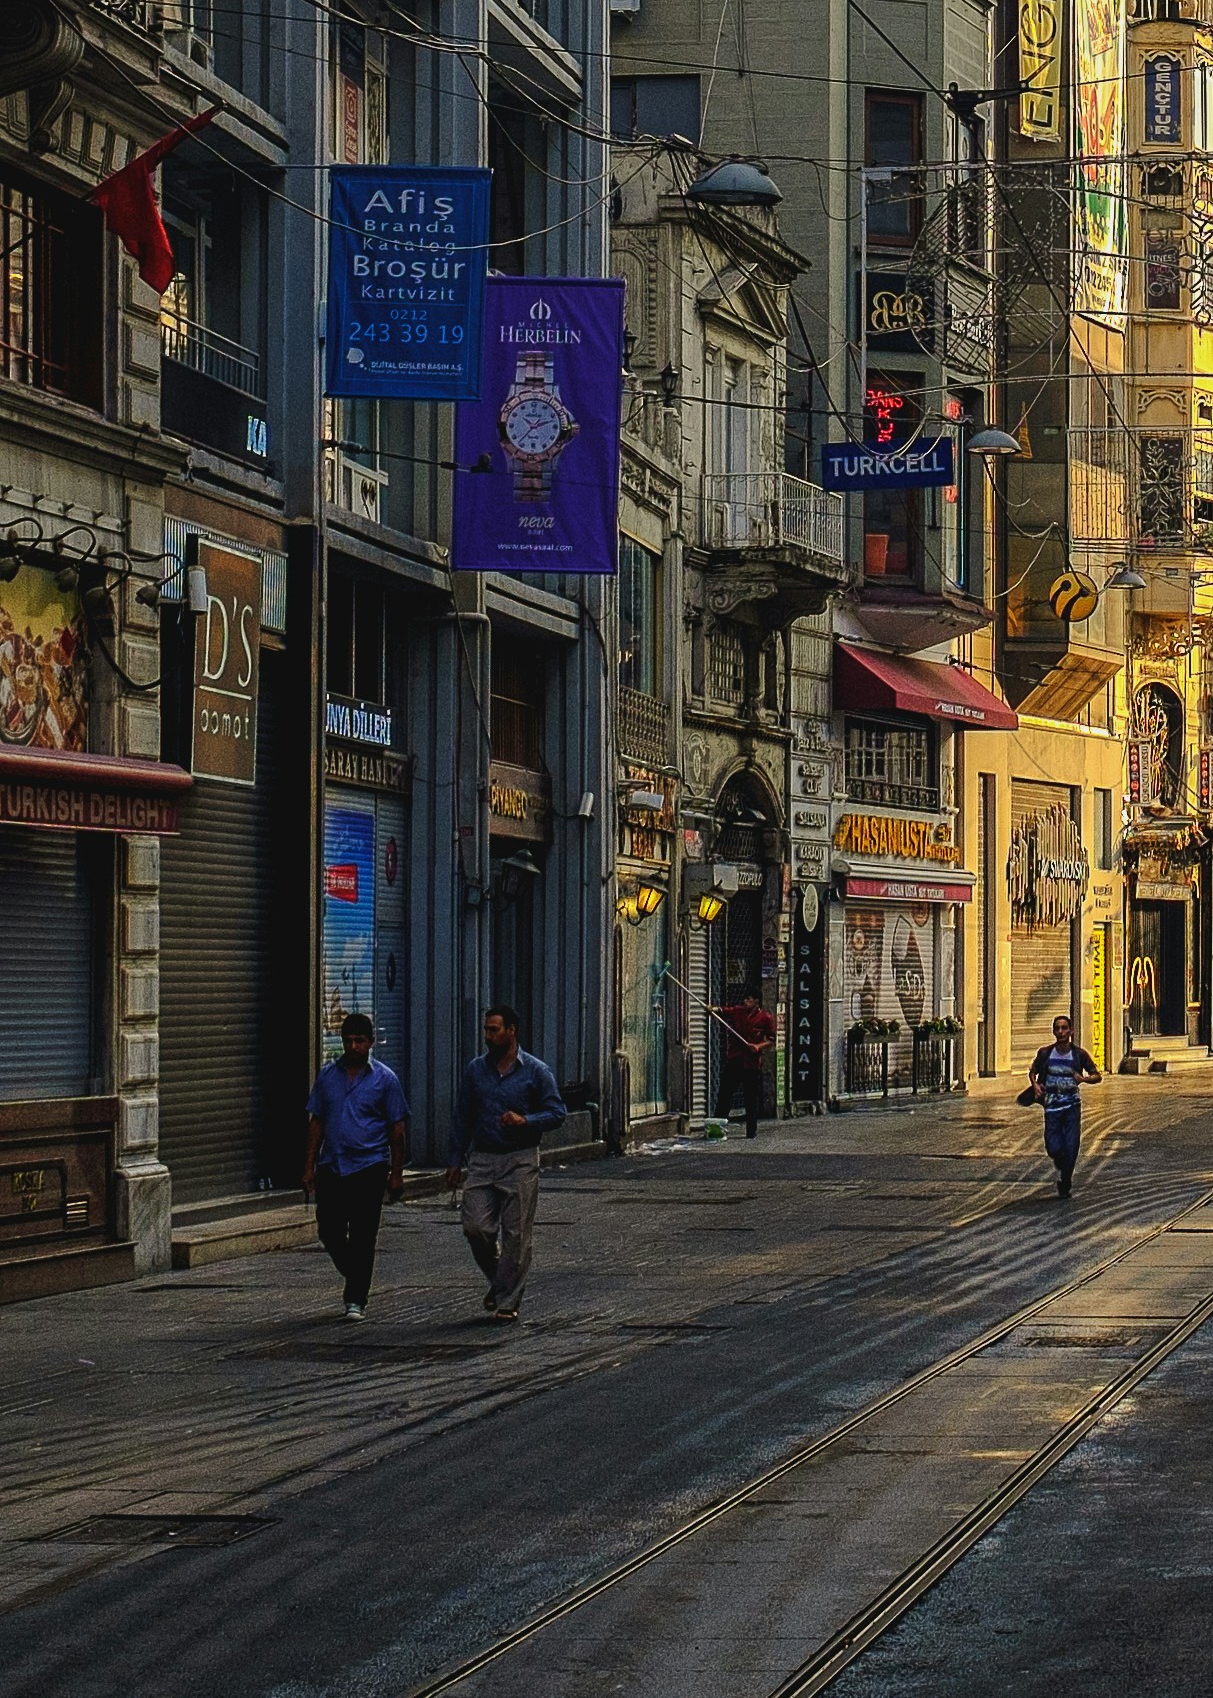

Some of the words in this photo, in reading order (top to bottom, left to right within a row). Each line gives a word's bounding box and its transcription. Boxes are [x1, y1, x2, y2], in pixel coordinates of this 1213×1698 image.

[364, 189, 454, 220] Afiş
[364, 220, 455, 233] Branda
[353, 255, 465, 283] Broşür
[361, 284, 455, 301] Kartvizit
[390, 310, 427, 320] 0212
[350, 322, 390, 341] 243
[400, 324, 428, 343] 39
[439, 325, 464, 344] 19
[500, 325, 581, 344] HERBELIN
[829, 453, 945, 479] TURKCELL
[518, 516, 555, 528] neva
[203, 594, 253, 687] D'S
[353, 703, 391, 745] DİLLERİ
[90, 792, 172, 828] DELIGHT
[852, 813, 899, 855] HASAN
[901, 819, 934, 858] USTA
[798, 945, 812, 1081] SALSANAT
